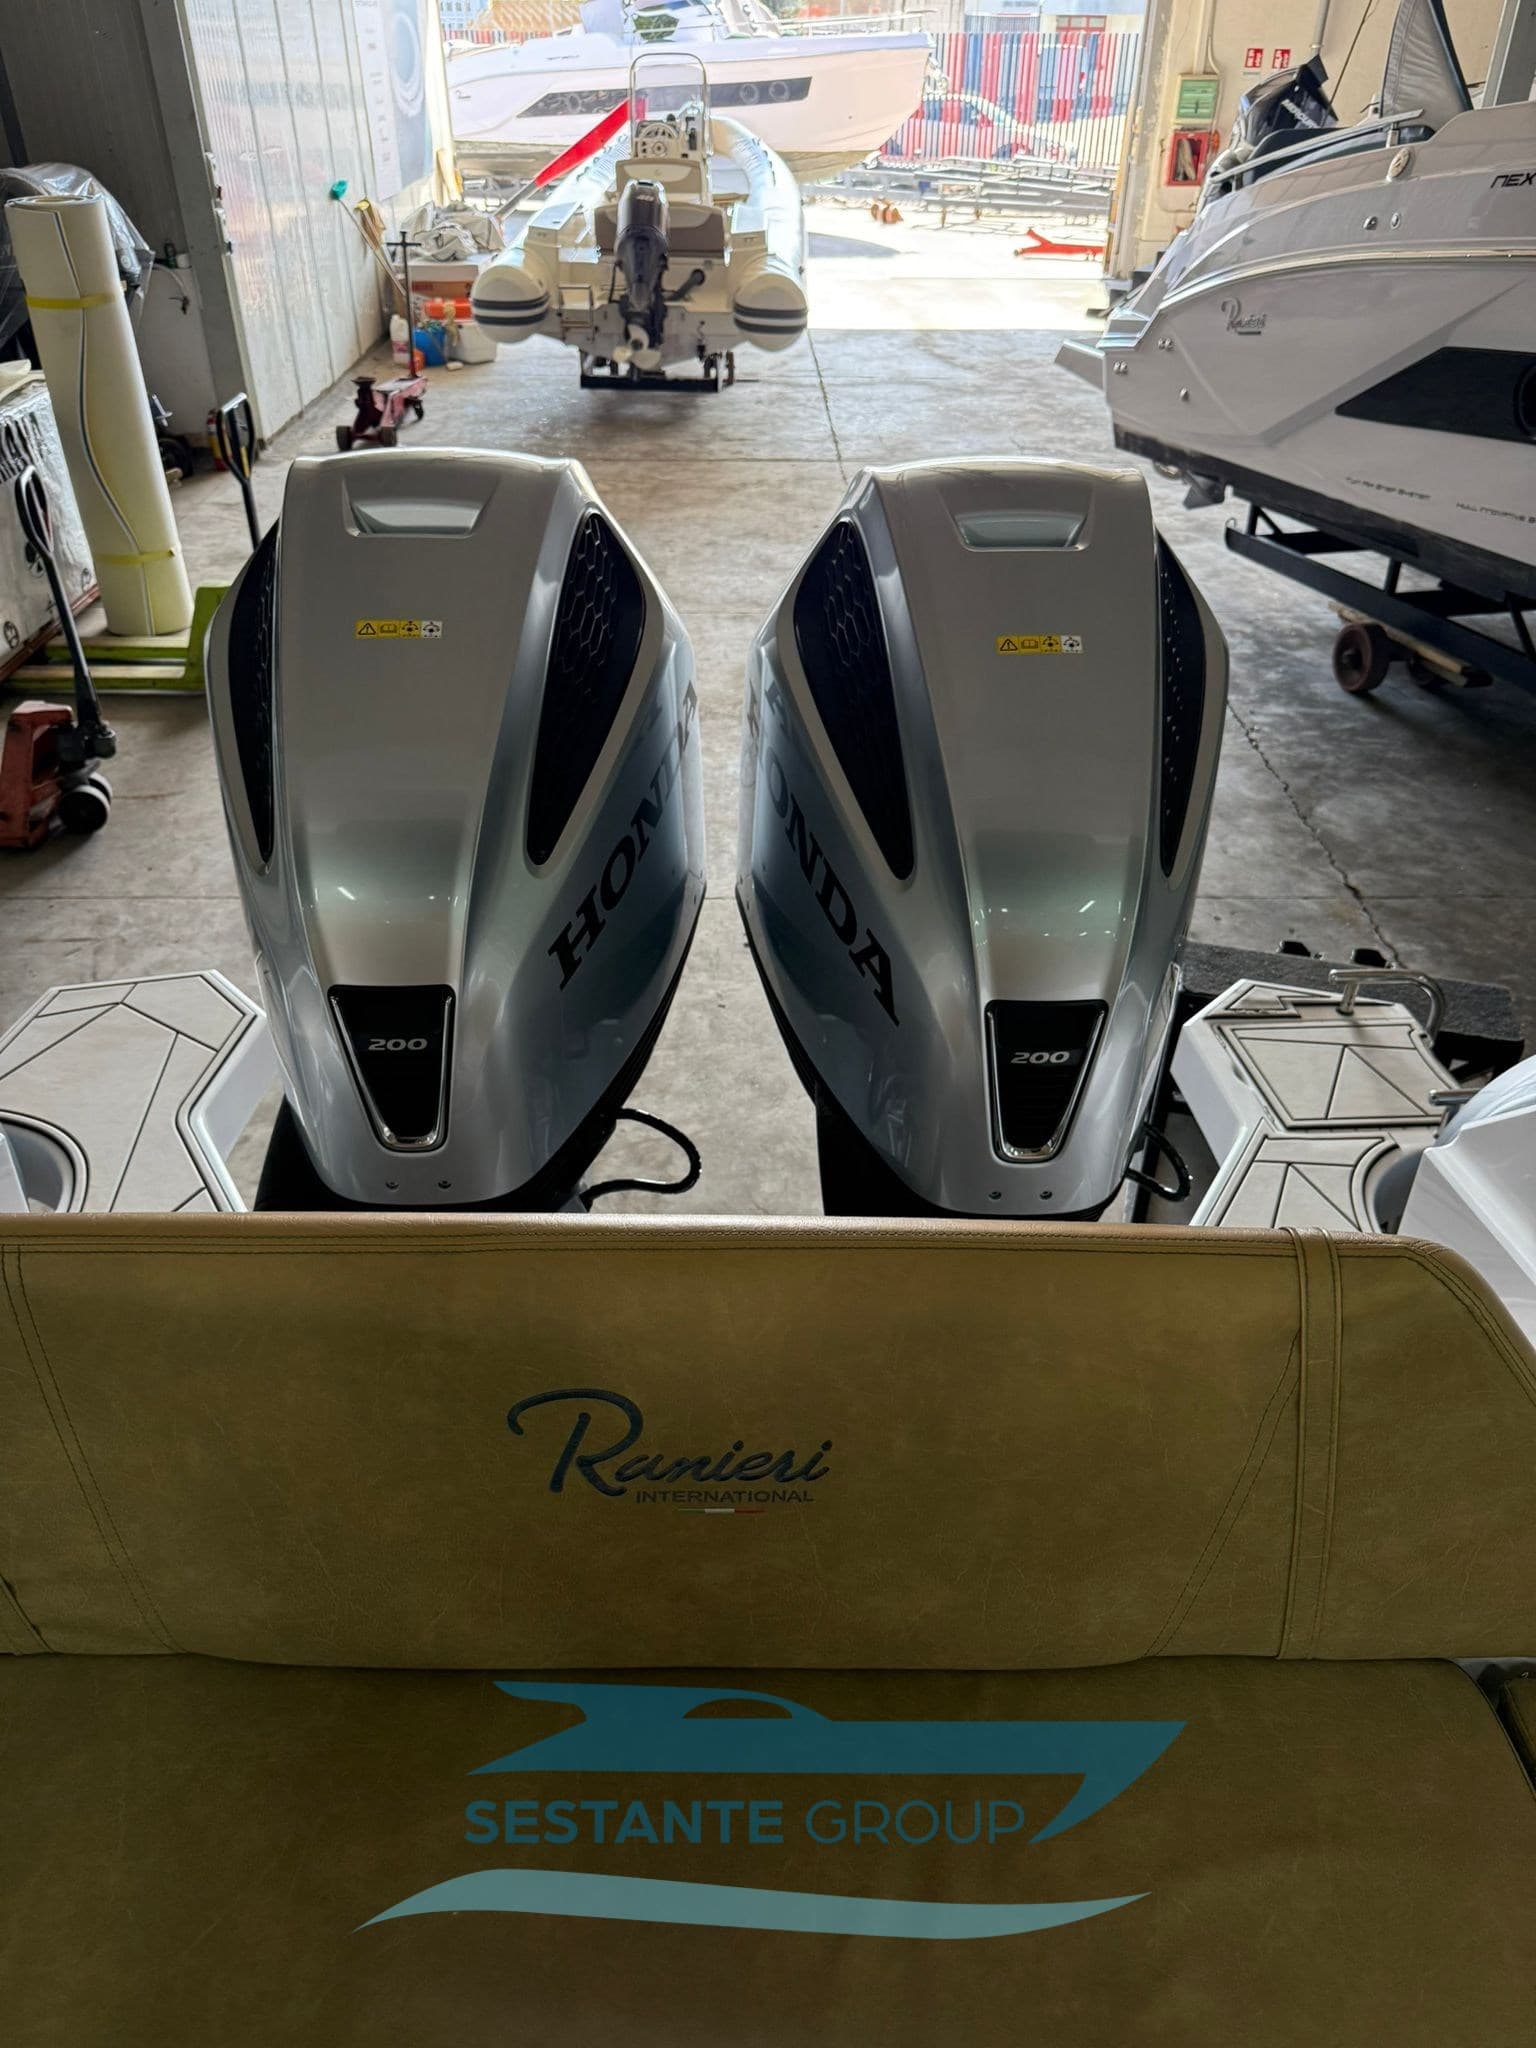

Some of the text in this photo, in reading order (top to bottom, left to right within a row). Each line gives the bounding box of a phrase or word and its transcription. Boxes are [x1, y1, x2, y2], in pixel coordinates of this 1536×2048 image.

[368, 1038, 428, 1051] 200
[1010, 1051, 1070, 1064] 200
[507, 1388, 833, 1497] Ranieri
[636, 1490, 814, 1503] INTERNATIONAL
